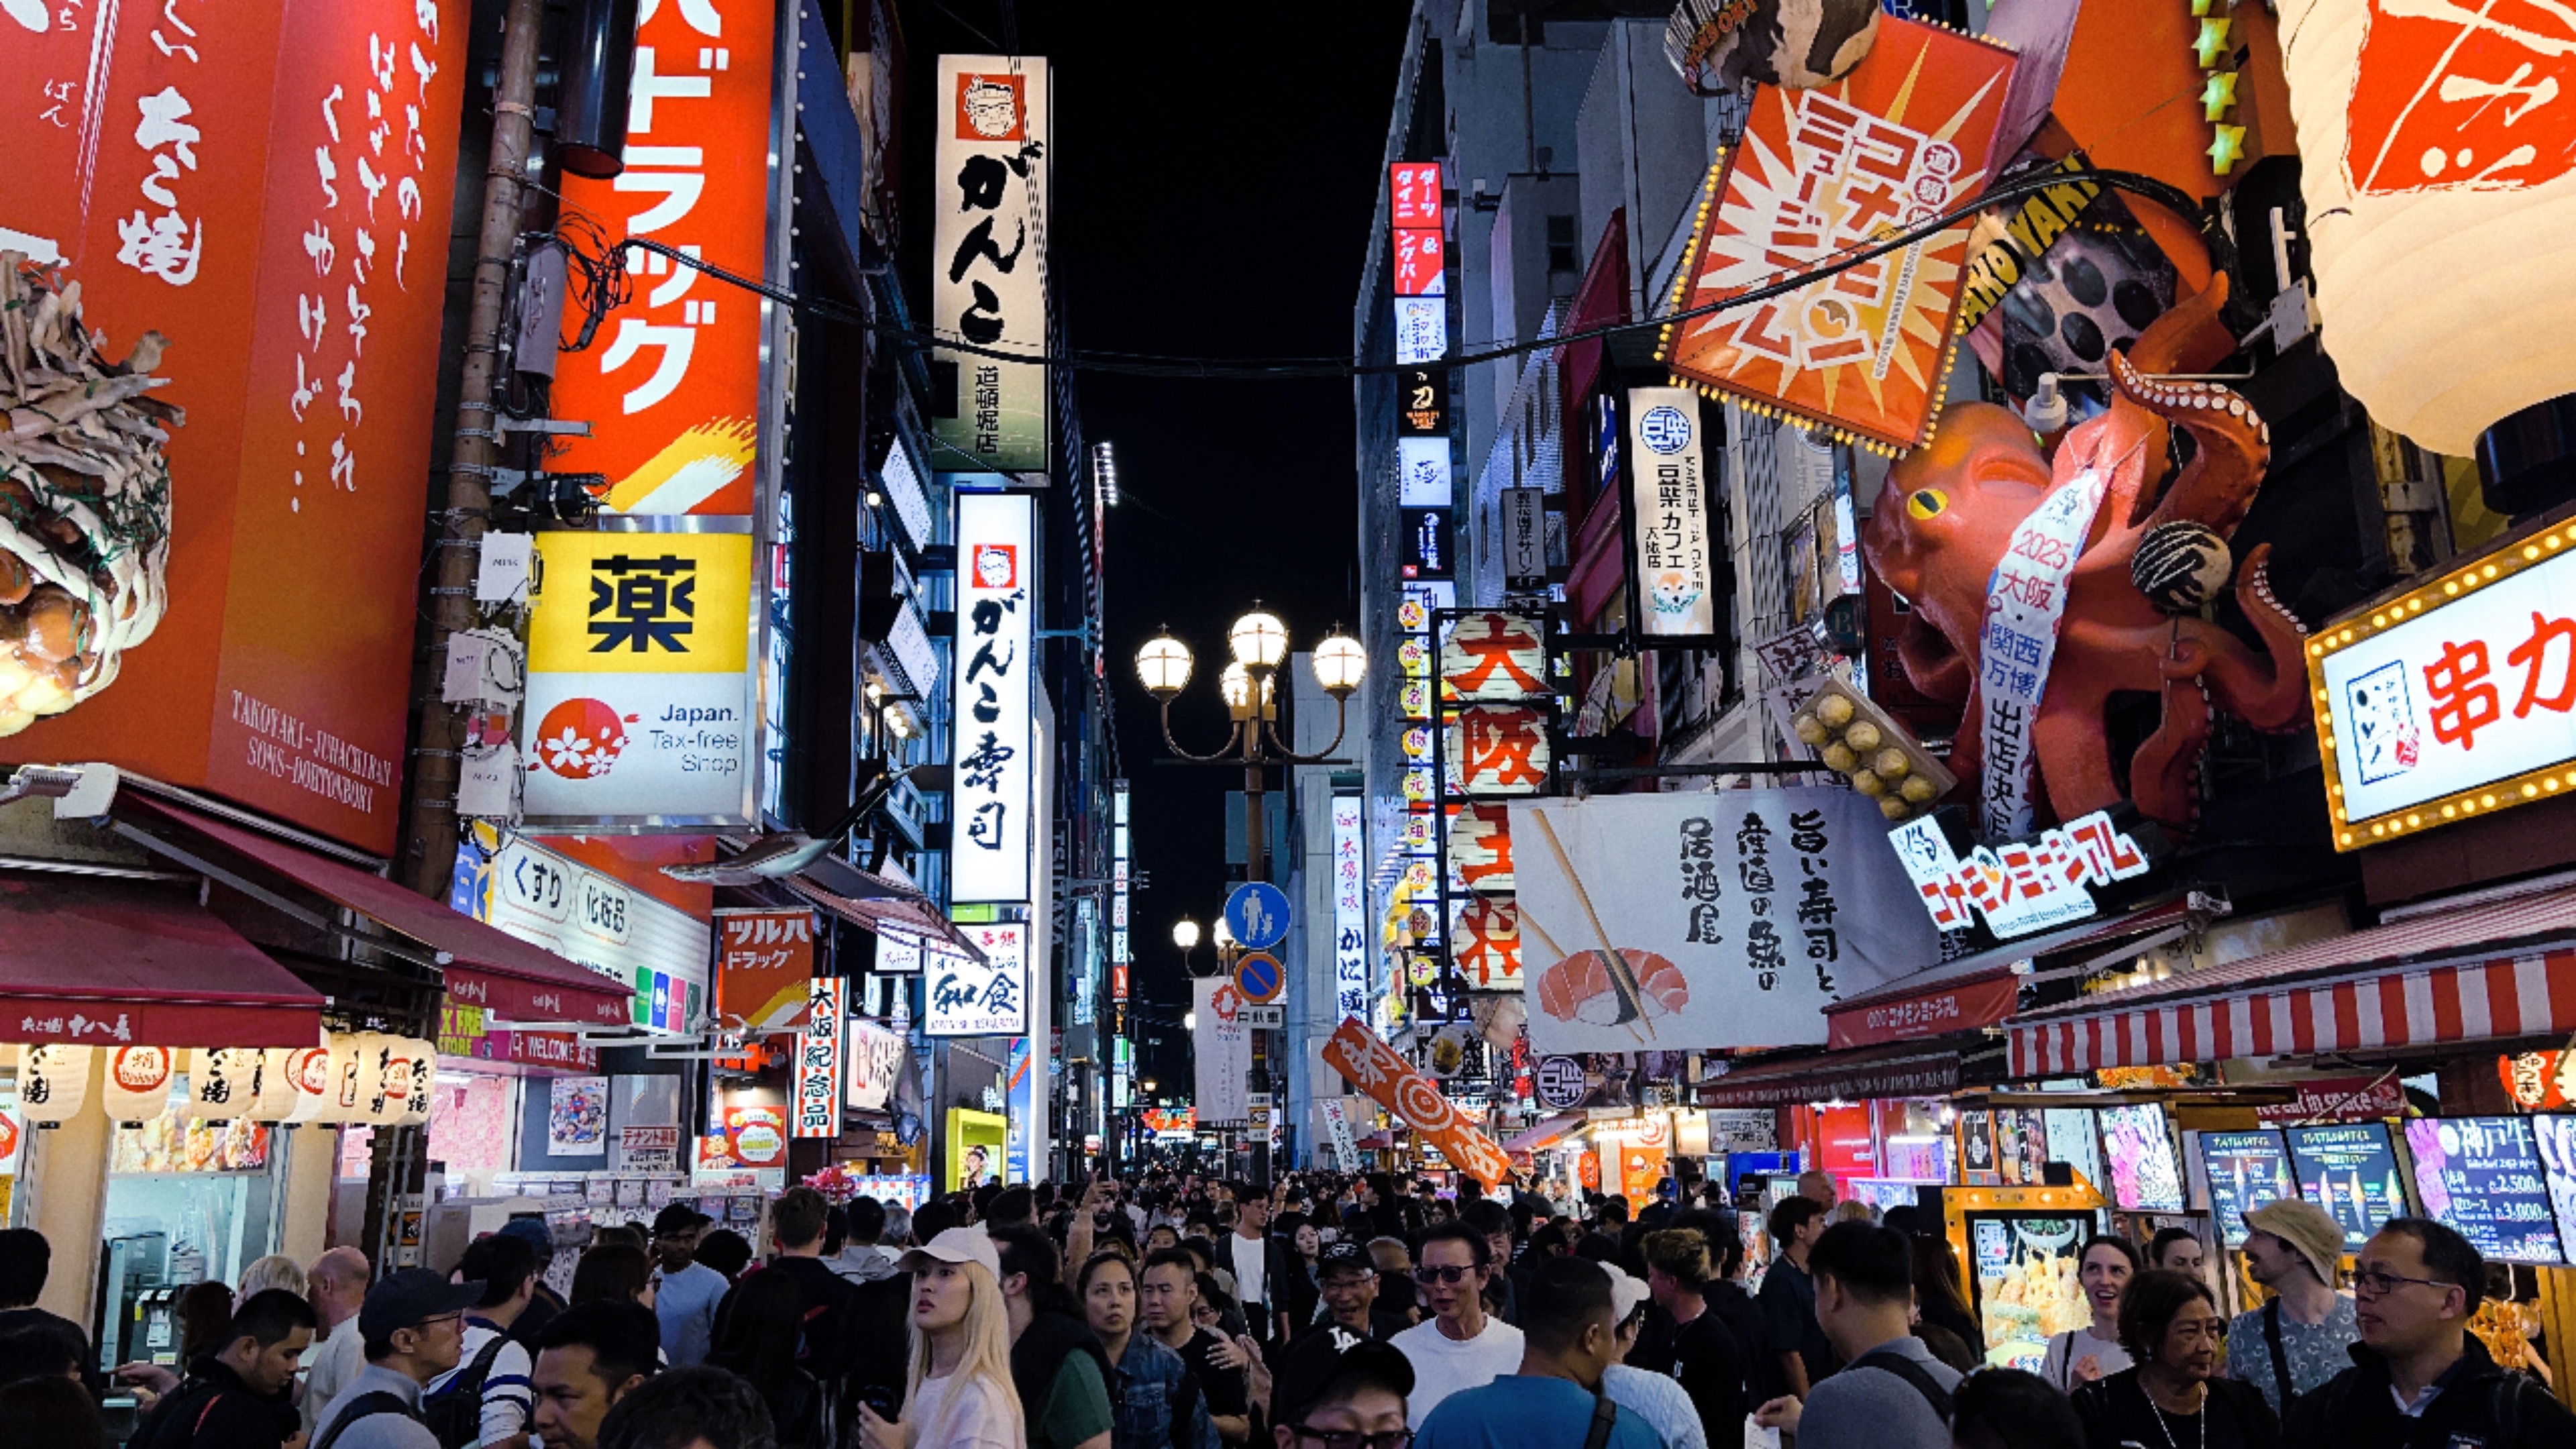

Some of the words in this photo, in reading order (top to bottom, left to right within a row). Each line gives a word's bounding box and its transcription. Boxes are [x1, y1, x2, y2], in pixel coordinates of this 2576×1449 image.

[949, 140, 1044, 345] がんこ
[975, 365, 1000, 455] 道頓堀店
[1658, 464, 1686, 570] 豆柴カフェ
[2011, 528, 2072, 571] 2025
[587, 554, 697, 653] 薬
[2000, 568, 2056, 613] 大阪
[1988, 622, 2044, 669] 関西
[1986, 655, 2035, 699] 万博
[659, 702, 739, 725] Japan.
[649, 729, 739, 750] Tax-free
[681, 753, 738, 775] Shop
[1989, 698, 2022, 837] 出店決定
[515, 855, 563, 908] くすり
[1680, 816, 1723, 944] 居酒屋
[586, 885, 625, 933] 化粧品
[727, 919, 810, 945] ツルハ
[727, 949, 794, 971] ドラッグ
[933, 972, 1020, 1016] 和食
[527, 1035, 574, 1062] WELCOME
